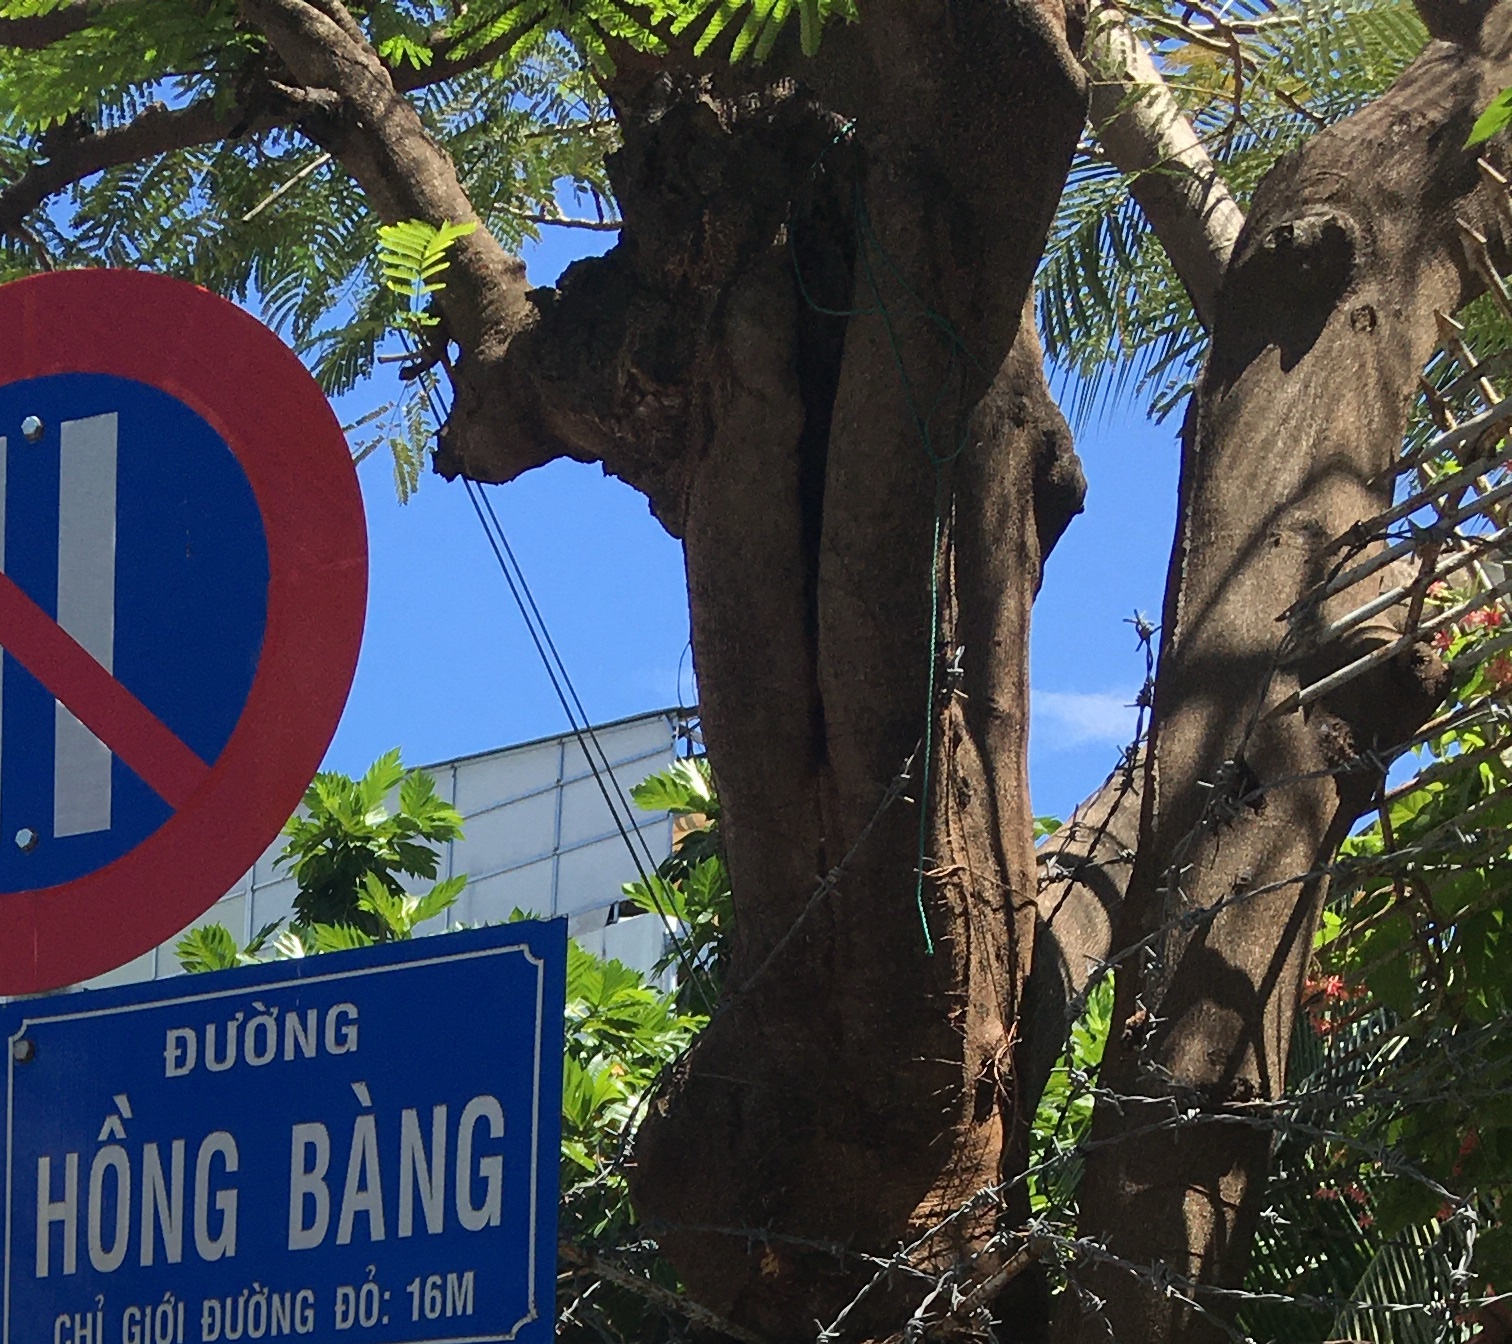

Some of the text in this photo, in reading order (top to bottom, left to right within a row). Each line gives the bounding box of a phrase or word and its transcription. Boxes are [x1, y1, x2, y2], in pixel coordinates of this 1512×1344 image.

[163, 1001, 360, 1078] ĐƯỜNG
[35, 1081, 505, 1278] HỒNG BÀNG
[201, 1283, 315, 1343] ĐƯỜNG
[334, 1264, 391, 1329] ĐỎ:
[405, 1271, 476, 1323] 16M
